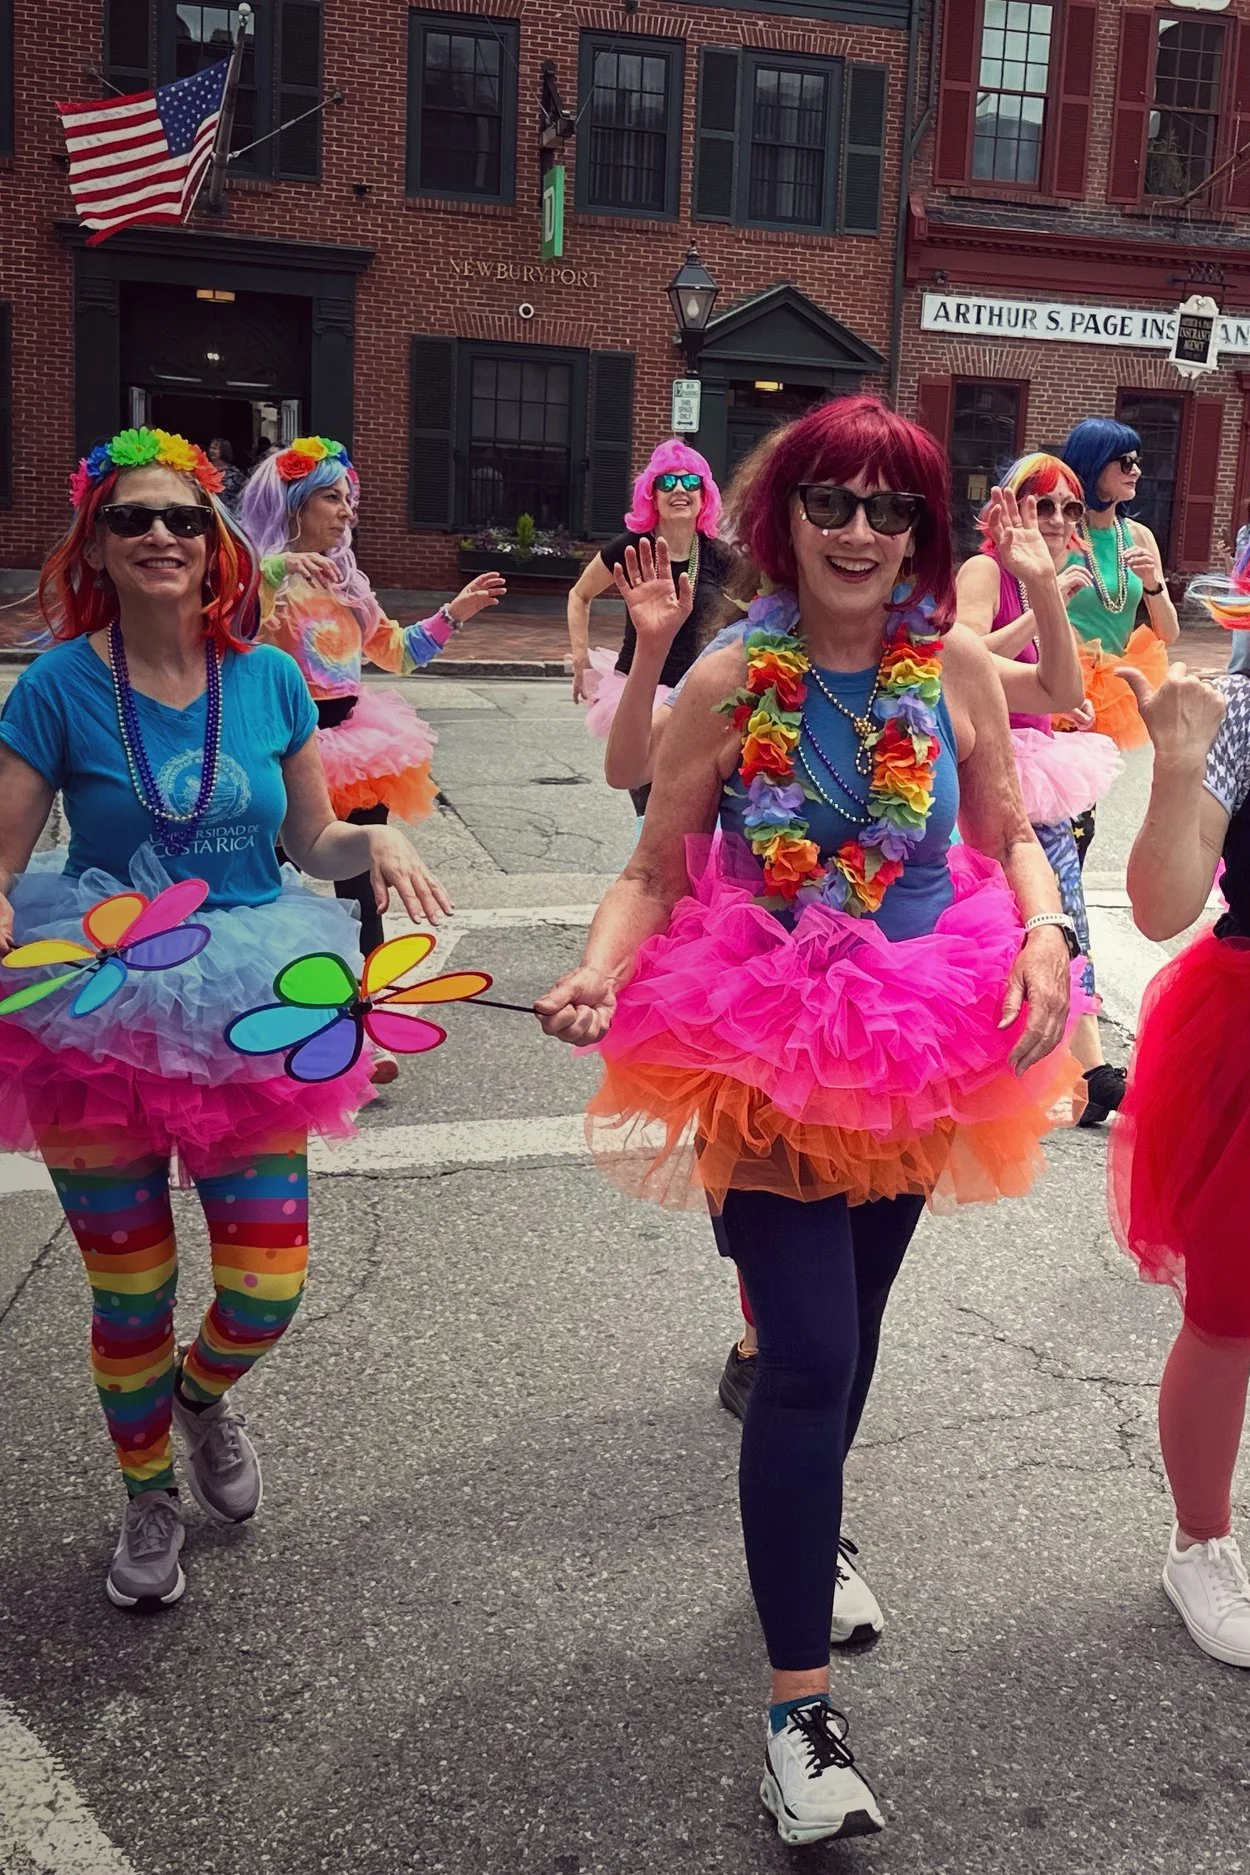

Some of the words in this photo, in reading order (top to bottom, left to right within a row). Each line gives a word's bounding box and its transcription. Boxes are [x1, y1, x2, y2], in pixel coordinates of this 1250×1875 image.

[450, 258, 601, 288] NEWBURYPORT
[933, 301, 1038, 330] ARTHUR
[1046, 310, 1064, 331] S.
[1070, 312, 1133, 337] PAGE
[247, 824, 260, 834] DE
[216, 835, 255, 853] RICA
